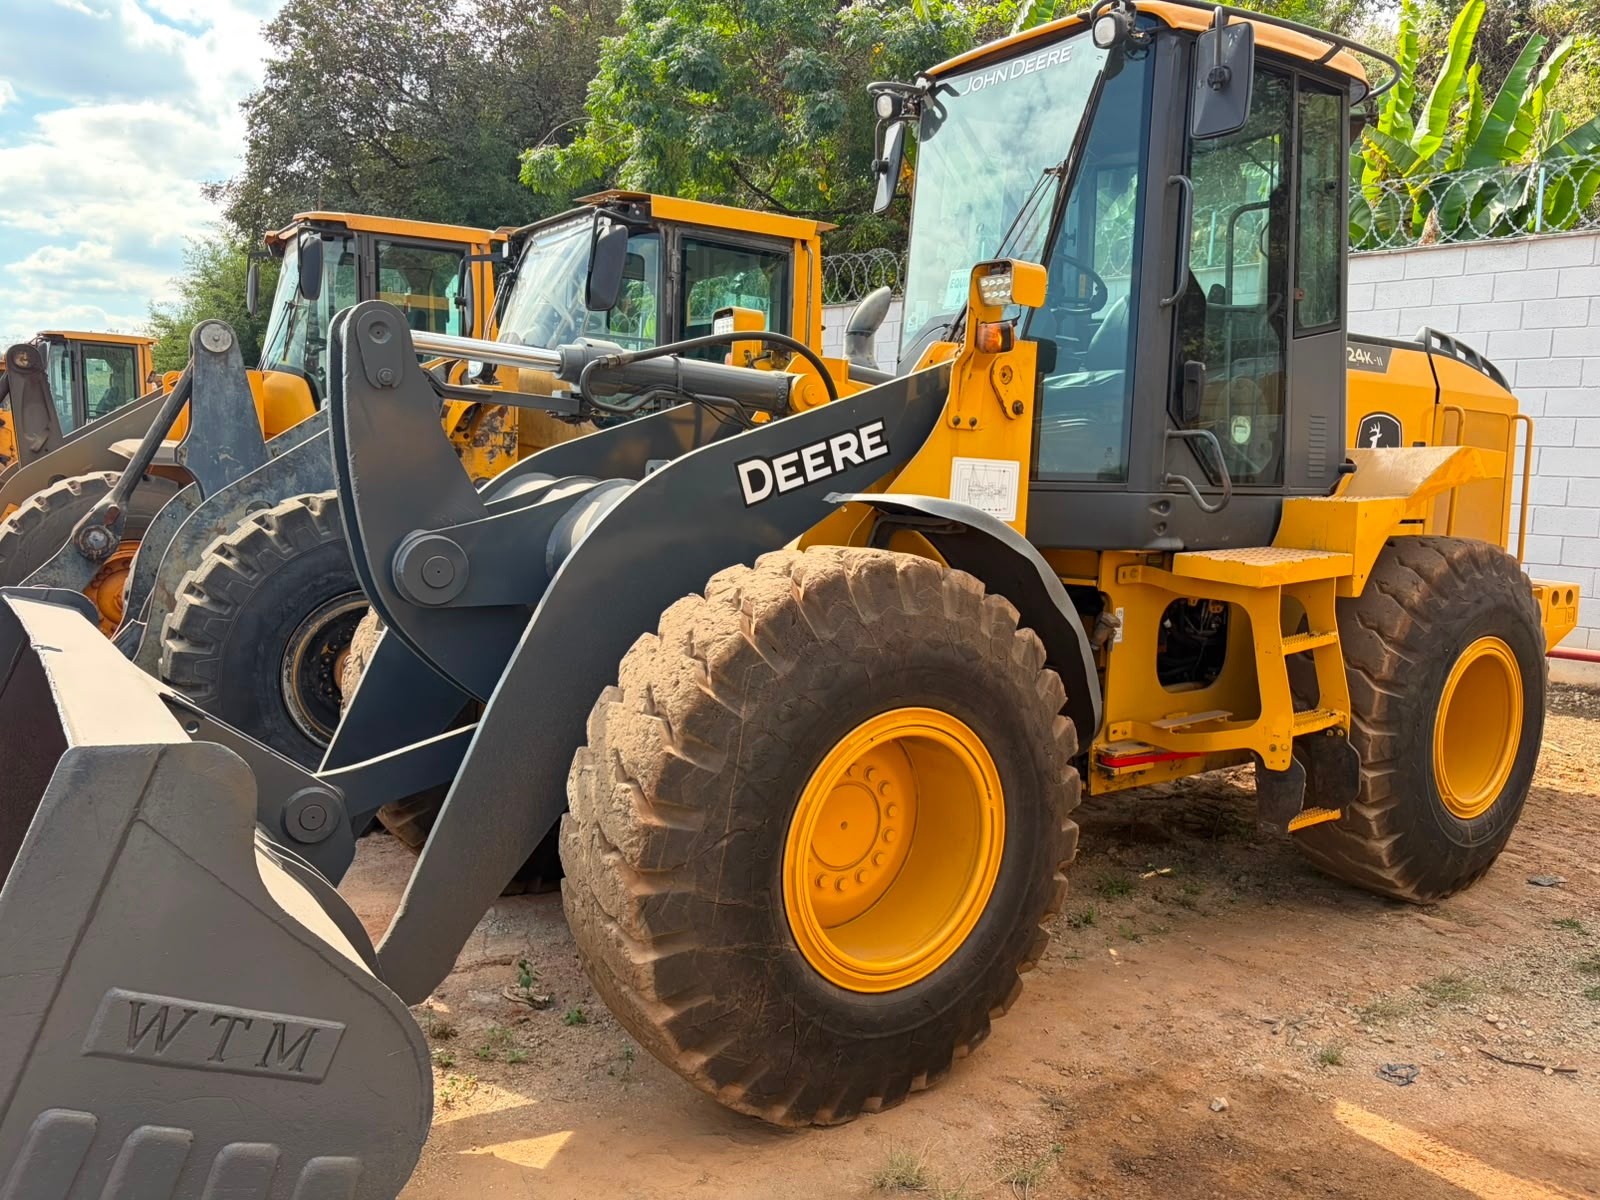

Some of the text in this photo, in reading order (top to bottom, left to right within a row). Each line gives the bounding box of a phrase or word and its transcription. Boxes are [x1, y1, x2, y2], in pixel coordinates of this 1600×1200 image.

[961, 45, 1073, 96] JOHN DEERE
[737, 421, 888, 505] DEERE
[127, 1000, 320, 1072] WTM
